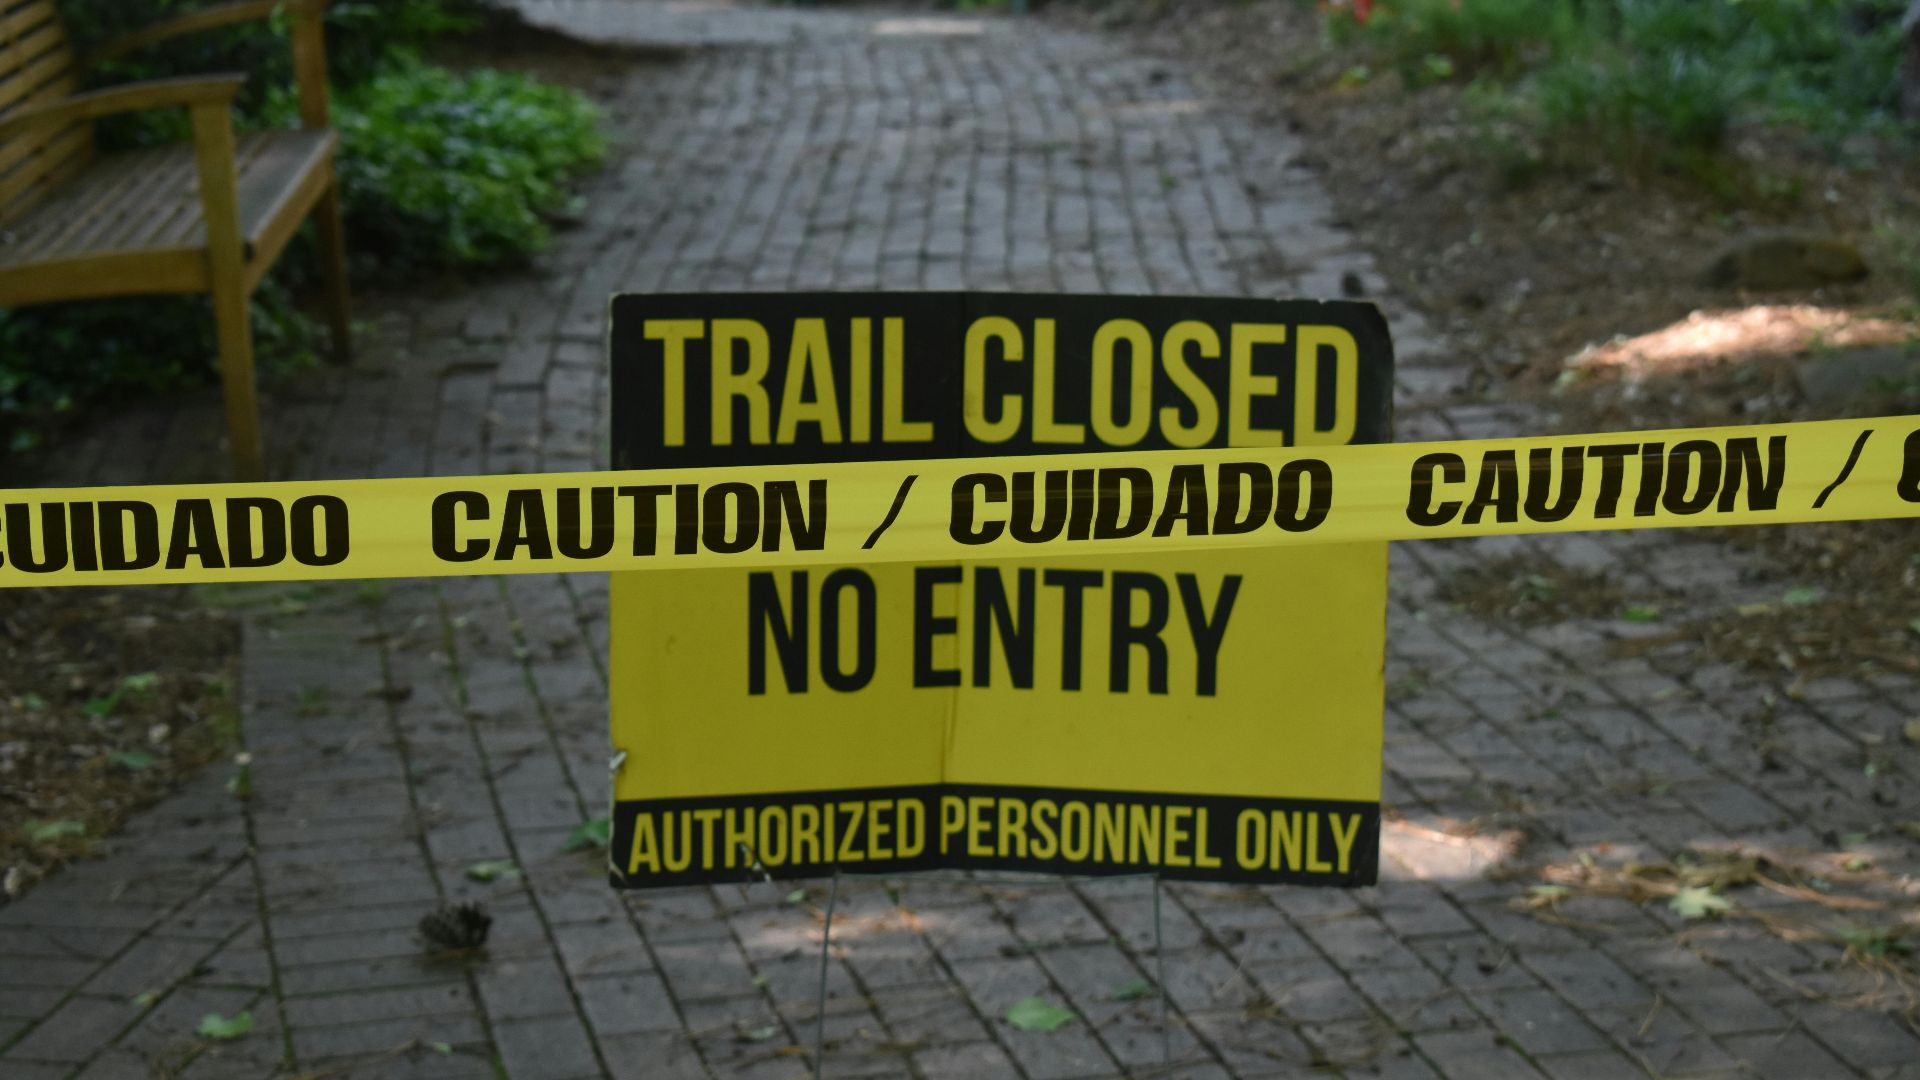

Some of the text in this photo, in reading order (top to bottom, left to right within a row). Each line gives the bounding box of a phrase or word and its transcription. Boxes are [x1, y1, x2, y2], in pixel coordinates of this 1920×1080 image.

[643, 316, 1360, 449] TRAIL CLOSED
[0, 494, 350, 574] UIDADO
[431, 479, 828, 563] CAUTION
[861, 474, 919, 550] /
[948, 458, 1333, 545] CUIDADO
[1405, 435, 1788, 527] CAUTION
[1811, 429, 1875, 509] /
[747, 566, 1243, 697] NO ENTRY
[628, 795, 1362, 875] AUTHORIZED PERSONNEL ONLY
